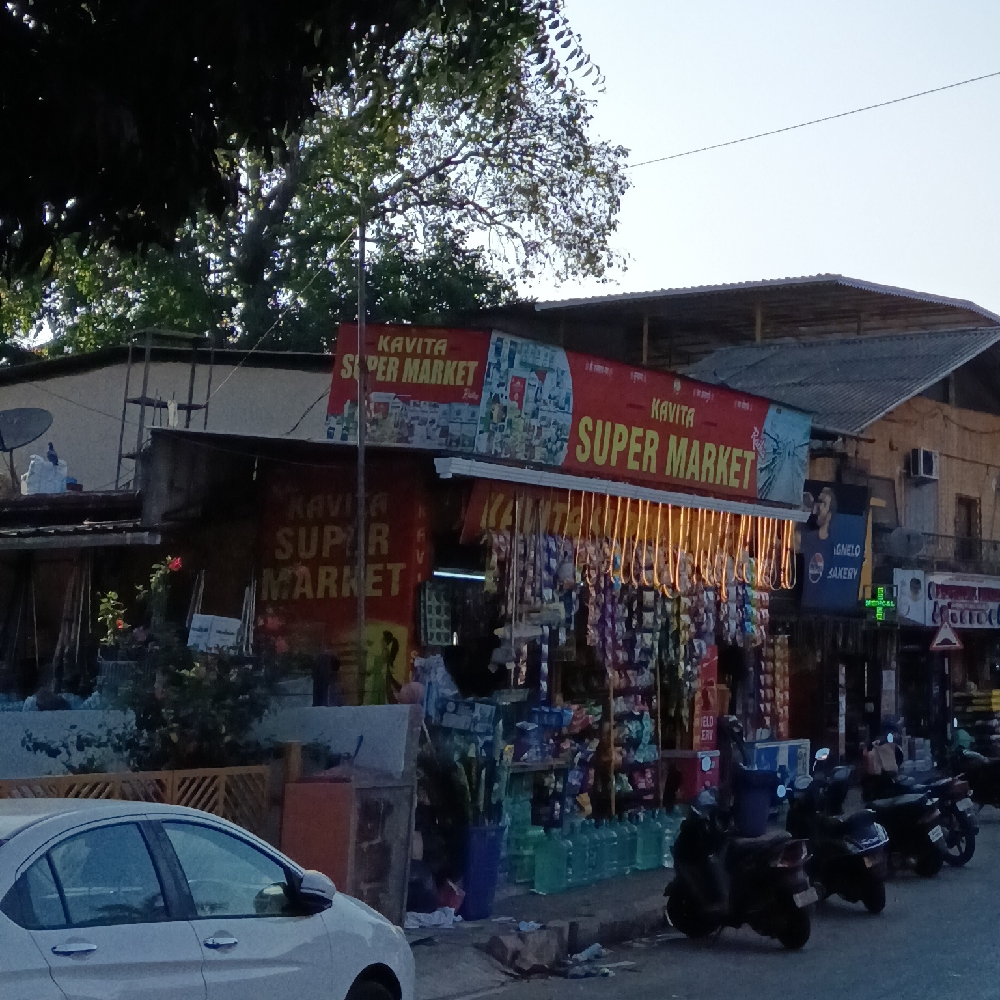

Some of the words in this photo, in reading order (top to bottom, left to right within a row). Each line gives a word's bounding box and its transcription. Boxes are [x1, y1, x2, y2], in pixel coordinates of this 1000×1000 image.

[377, 335, 448, 356] KAVITA
[402, 357, 479, 386] MARKET
[651, 398, 695, 428] KAVITA
[576, 416, 659, 474] SUPER
[665, 433, 756, 489] MARKET
[287, 491, 389, 520] KAVIA
